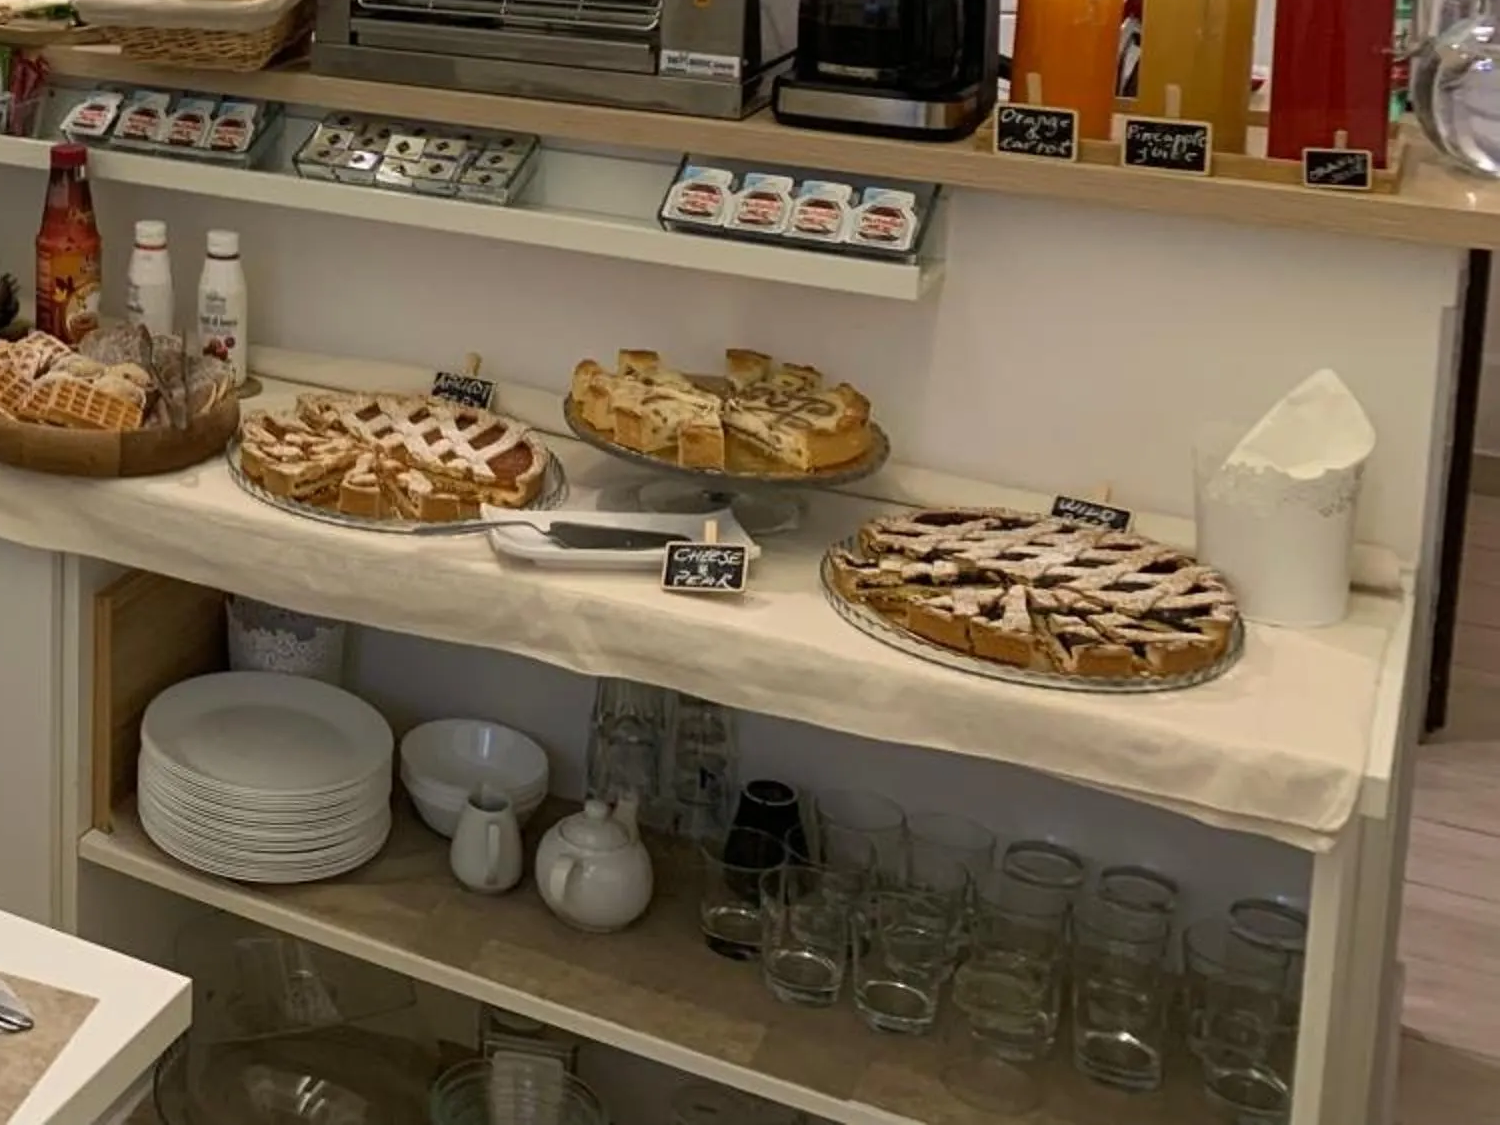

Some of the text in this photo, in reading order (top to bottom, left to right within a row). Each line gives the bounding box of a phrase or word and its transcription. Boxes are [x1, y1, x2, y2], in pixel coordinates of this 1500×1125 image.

[1001, 109, 1070, 137] Orange
[1127, 124, 1206, 153] Pineapple
[1133, 140, 1198, 164] juice
[673, 548, 743, 566] CHEESE
